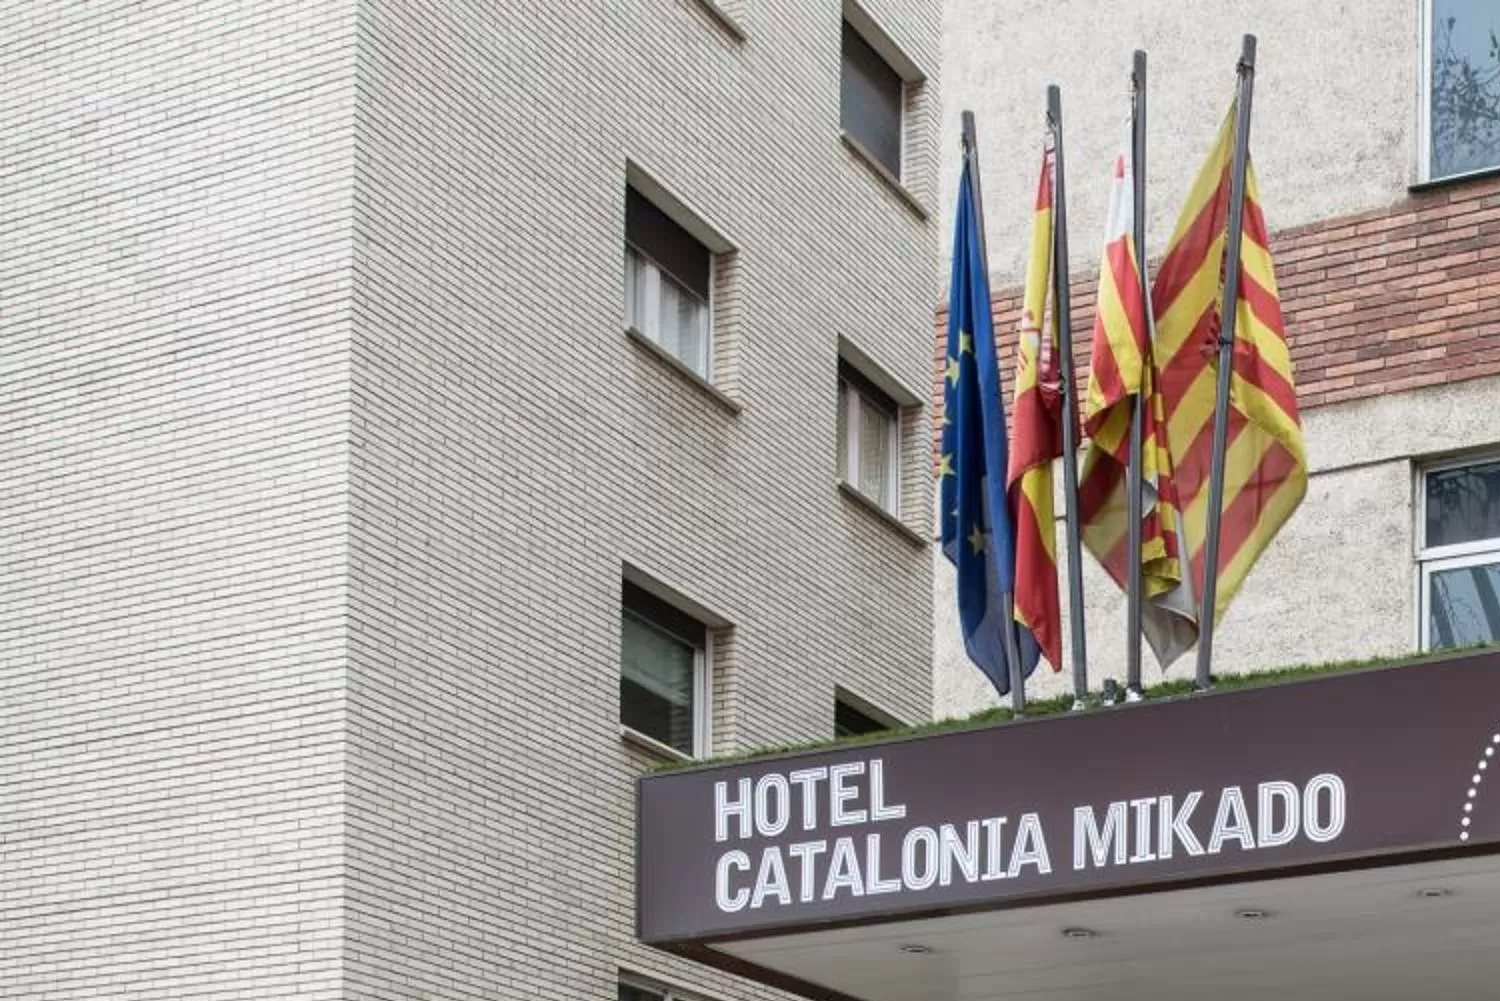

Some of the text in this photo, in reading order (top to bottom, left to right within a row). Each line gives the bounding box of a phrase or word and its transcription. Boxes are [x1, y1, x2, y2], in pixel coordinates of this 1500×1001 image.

[715, 758, 906, 842] HOTEL
[715, 773, 1347, 912] CATALONIA MIKADO
